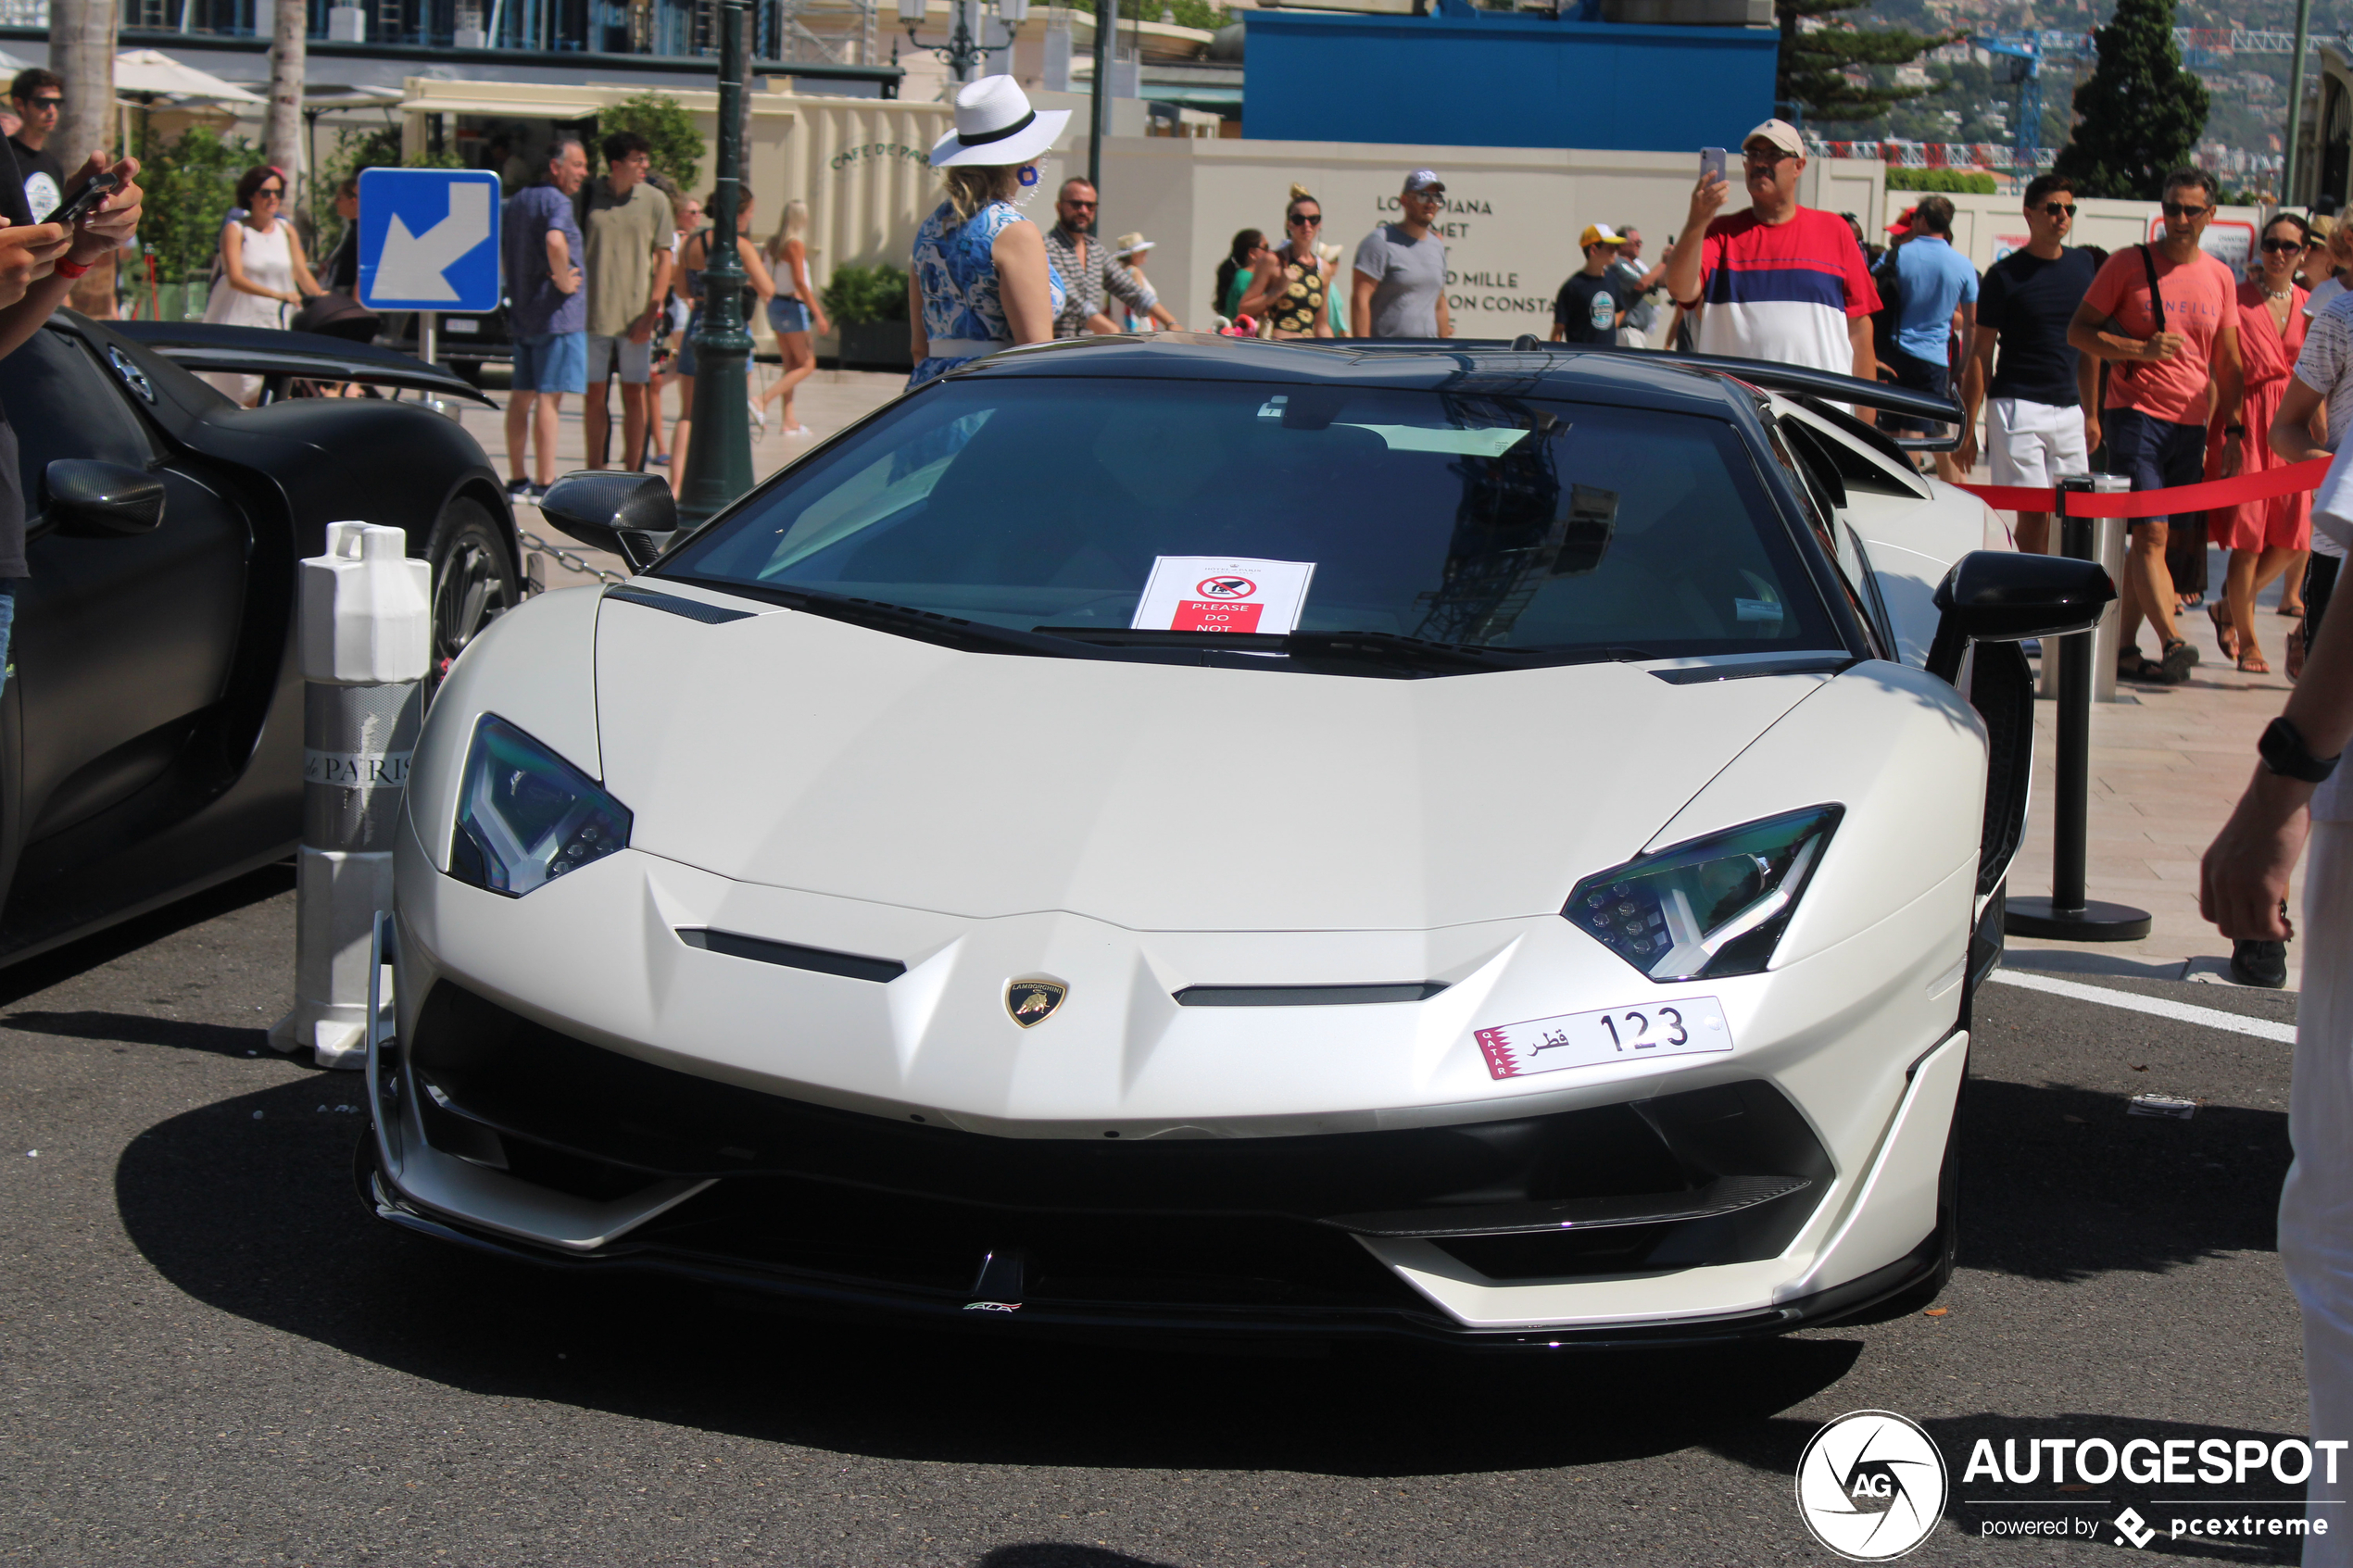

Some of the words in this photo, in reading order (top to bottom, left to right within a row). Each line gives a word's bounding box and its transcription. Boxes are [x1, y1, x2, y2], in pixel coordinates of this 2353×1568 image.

[875, 143, 896, 157] DE
[1464, 271, 1519, 288] MILLE
[1482, 295, 1556, 313] CONSTA
[1192, 603, 1249, 611] PLEASE
[1013, 984, 1062, 995] LAMBORGHINI
[1527, 1029, 1570, 1057] قطر
[1601, 1007, 1688, 1052] 123
[1482, 1032, 1506, 1075] QATAR
